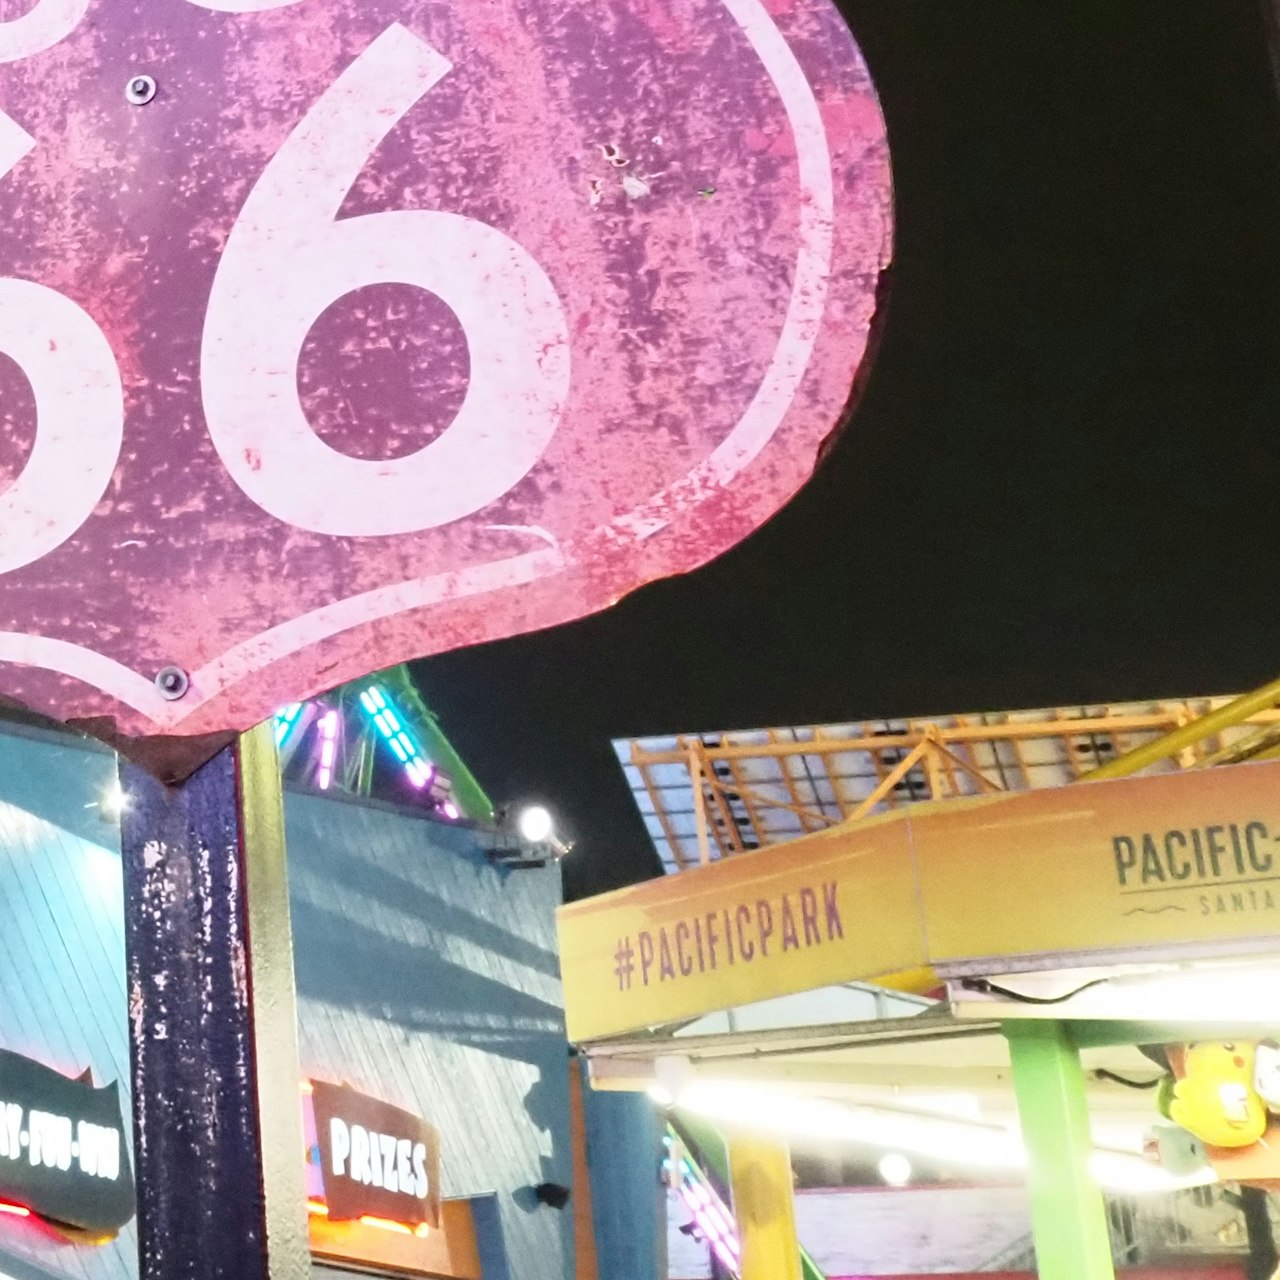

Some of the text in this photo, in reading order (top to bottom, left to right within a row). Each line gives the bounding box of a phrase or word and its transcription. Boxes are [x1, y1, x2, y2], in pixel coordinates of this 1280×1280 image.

[1113, 822, 1273, 885] PACIFIC
[614, 881, 844, 991] #PACIFICPARK
[1199, 890, 1276, 916] SANTA
[330, 1117, 428, 1199] PRIZES
